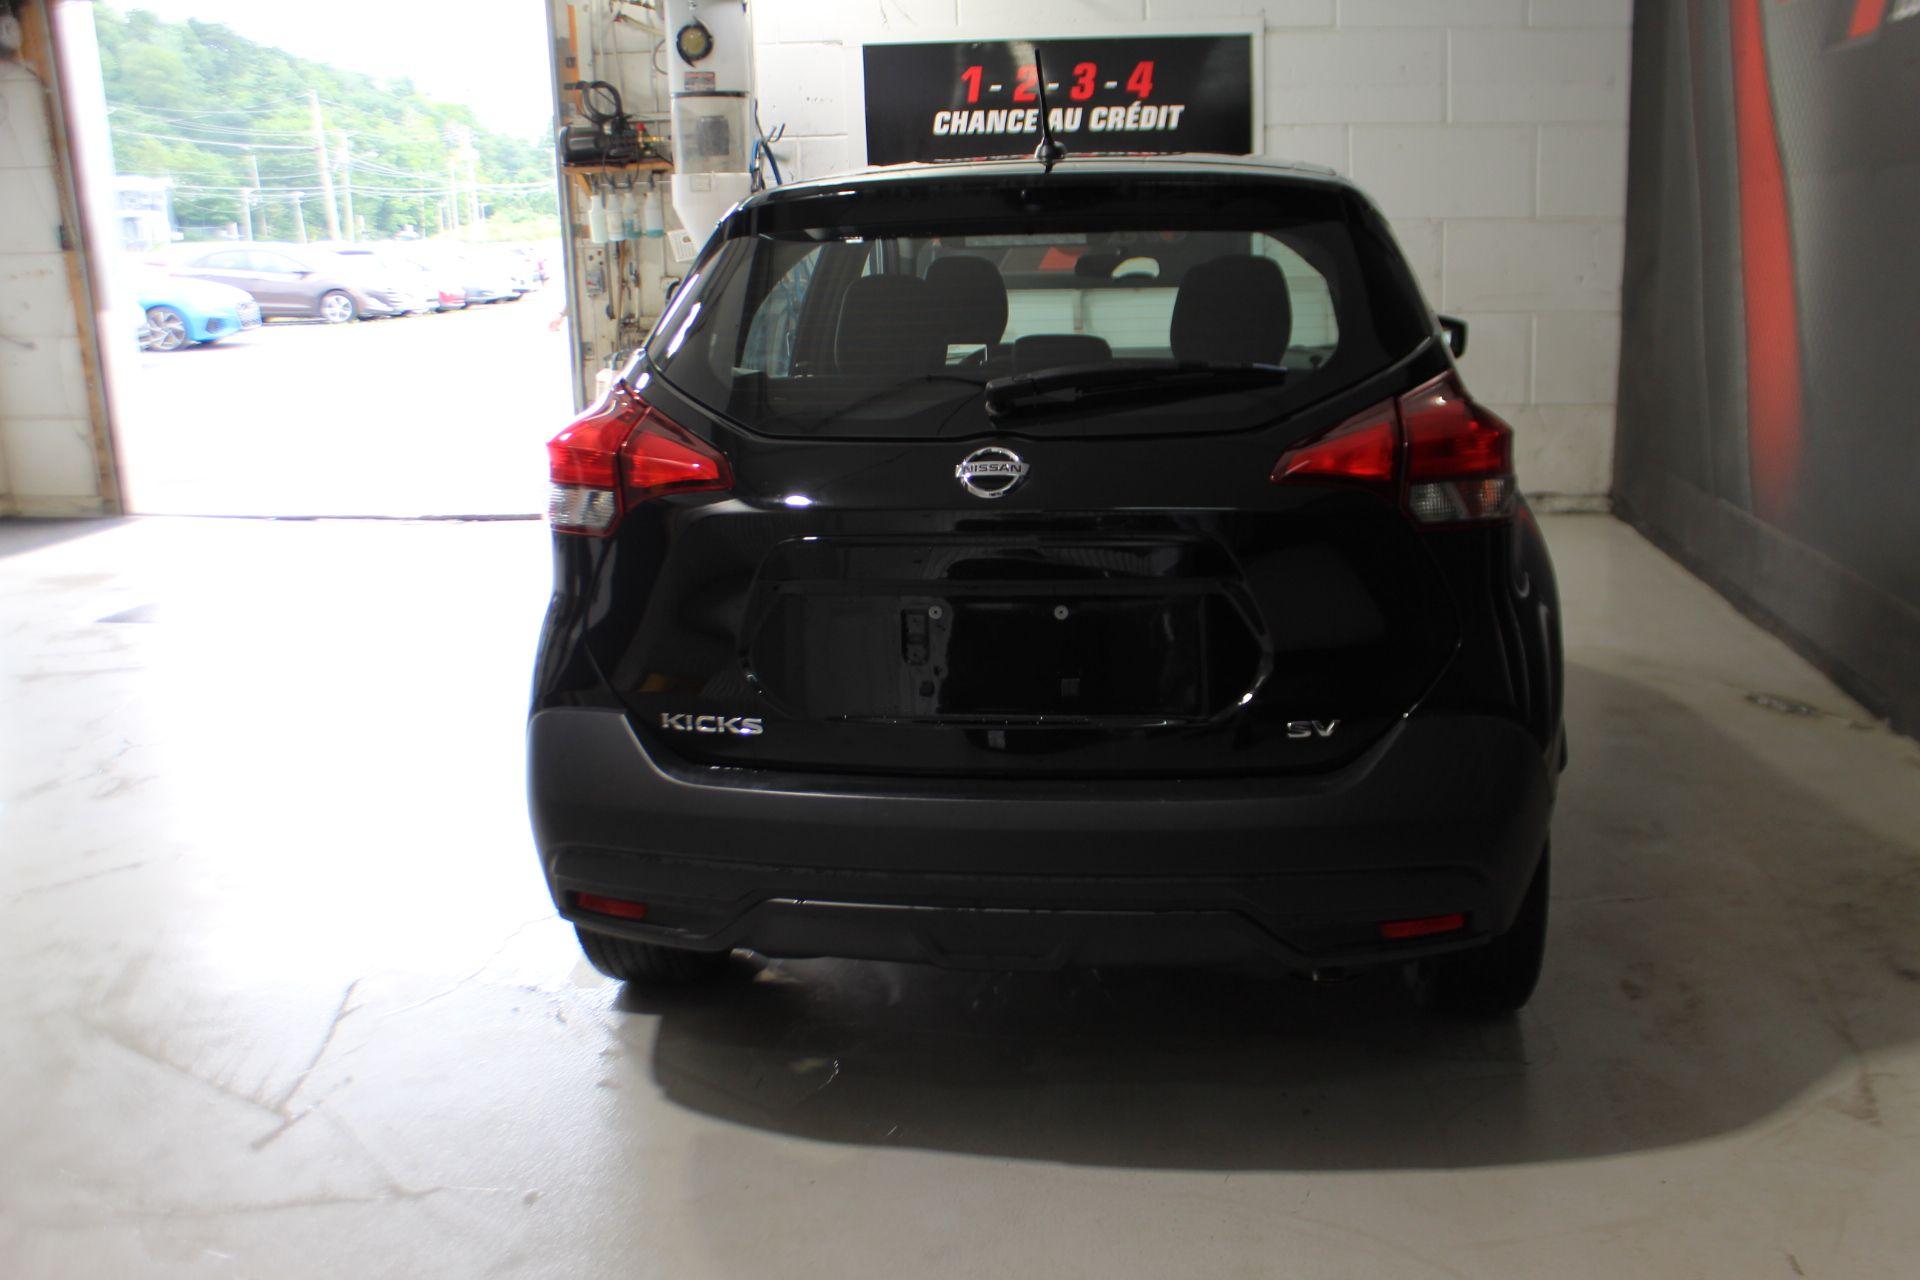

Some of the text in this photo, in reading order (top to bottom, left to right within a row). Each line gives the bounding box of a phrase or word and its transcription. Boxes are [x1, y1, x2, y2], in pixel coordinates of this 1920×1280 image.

[933, 100, 1185, 135] CHANCE AU CRÉDIT
[961, 462, 1022, 474] NISSAN
[661, 712, 763, 735] KICKS
[1286, 720, 1340, 738] SV
